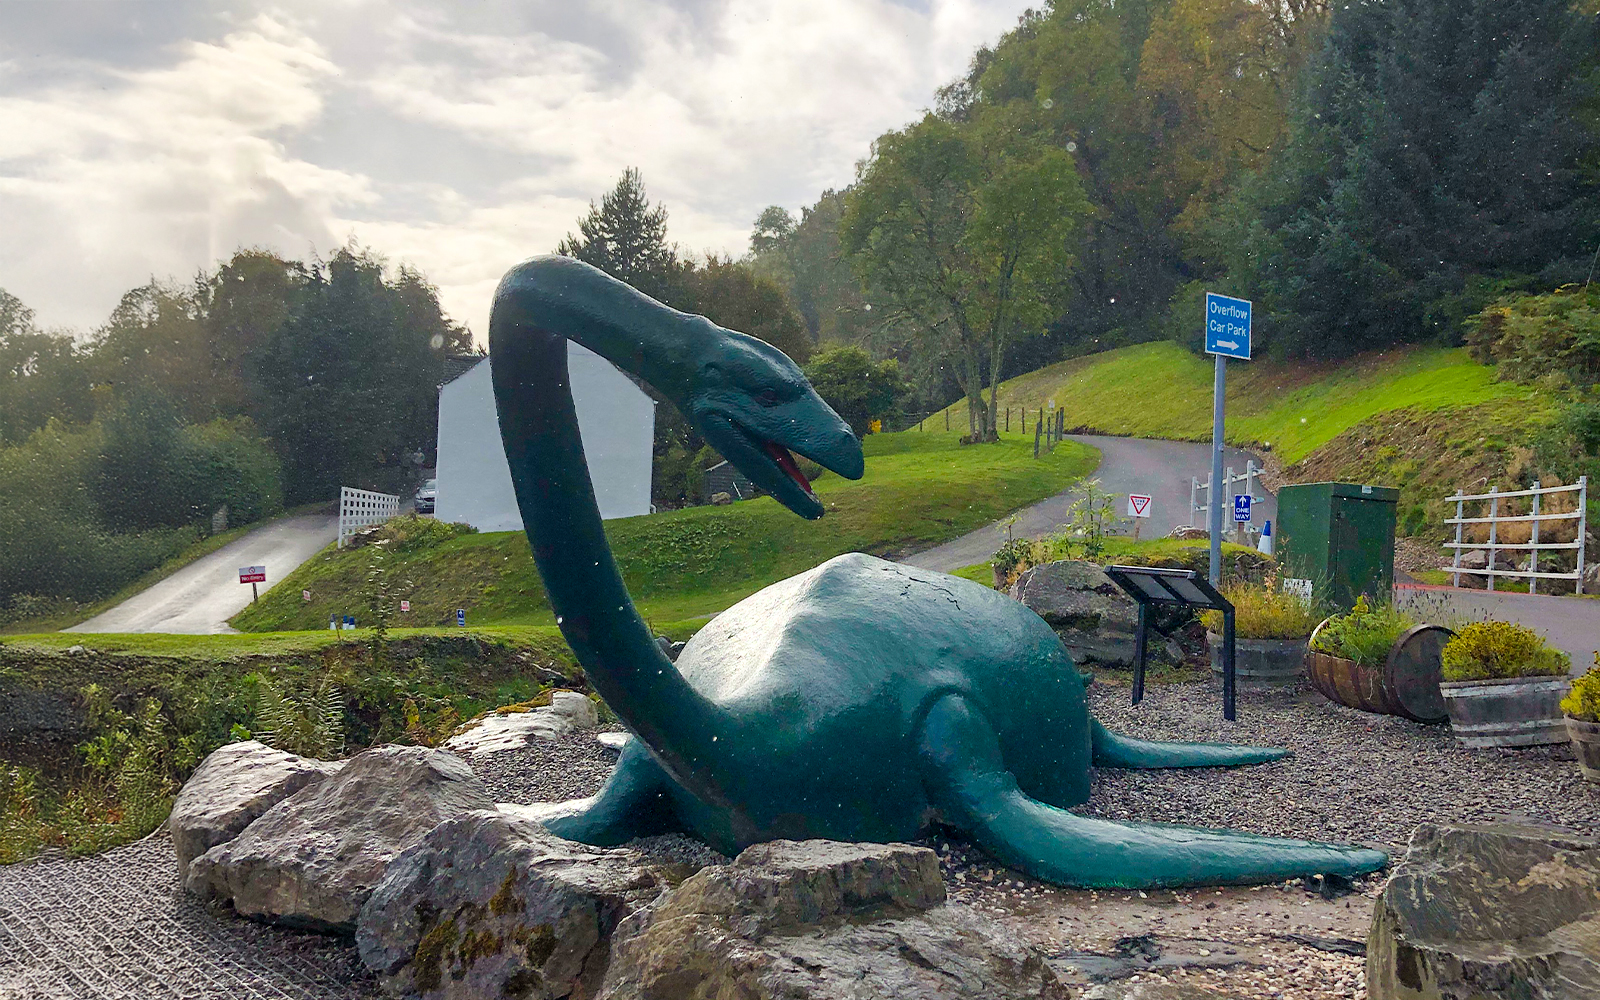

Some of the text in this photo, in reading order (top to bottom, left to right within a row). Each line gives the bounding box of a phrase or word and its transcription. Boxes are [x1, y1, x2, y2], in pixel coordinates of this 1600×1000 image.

[1210, 301, 1248, 320] Overflow
[1209, 319, 1247, 337] Car Park
